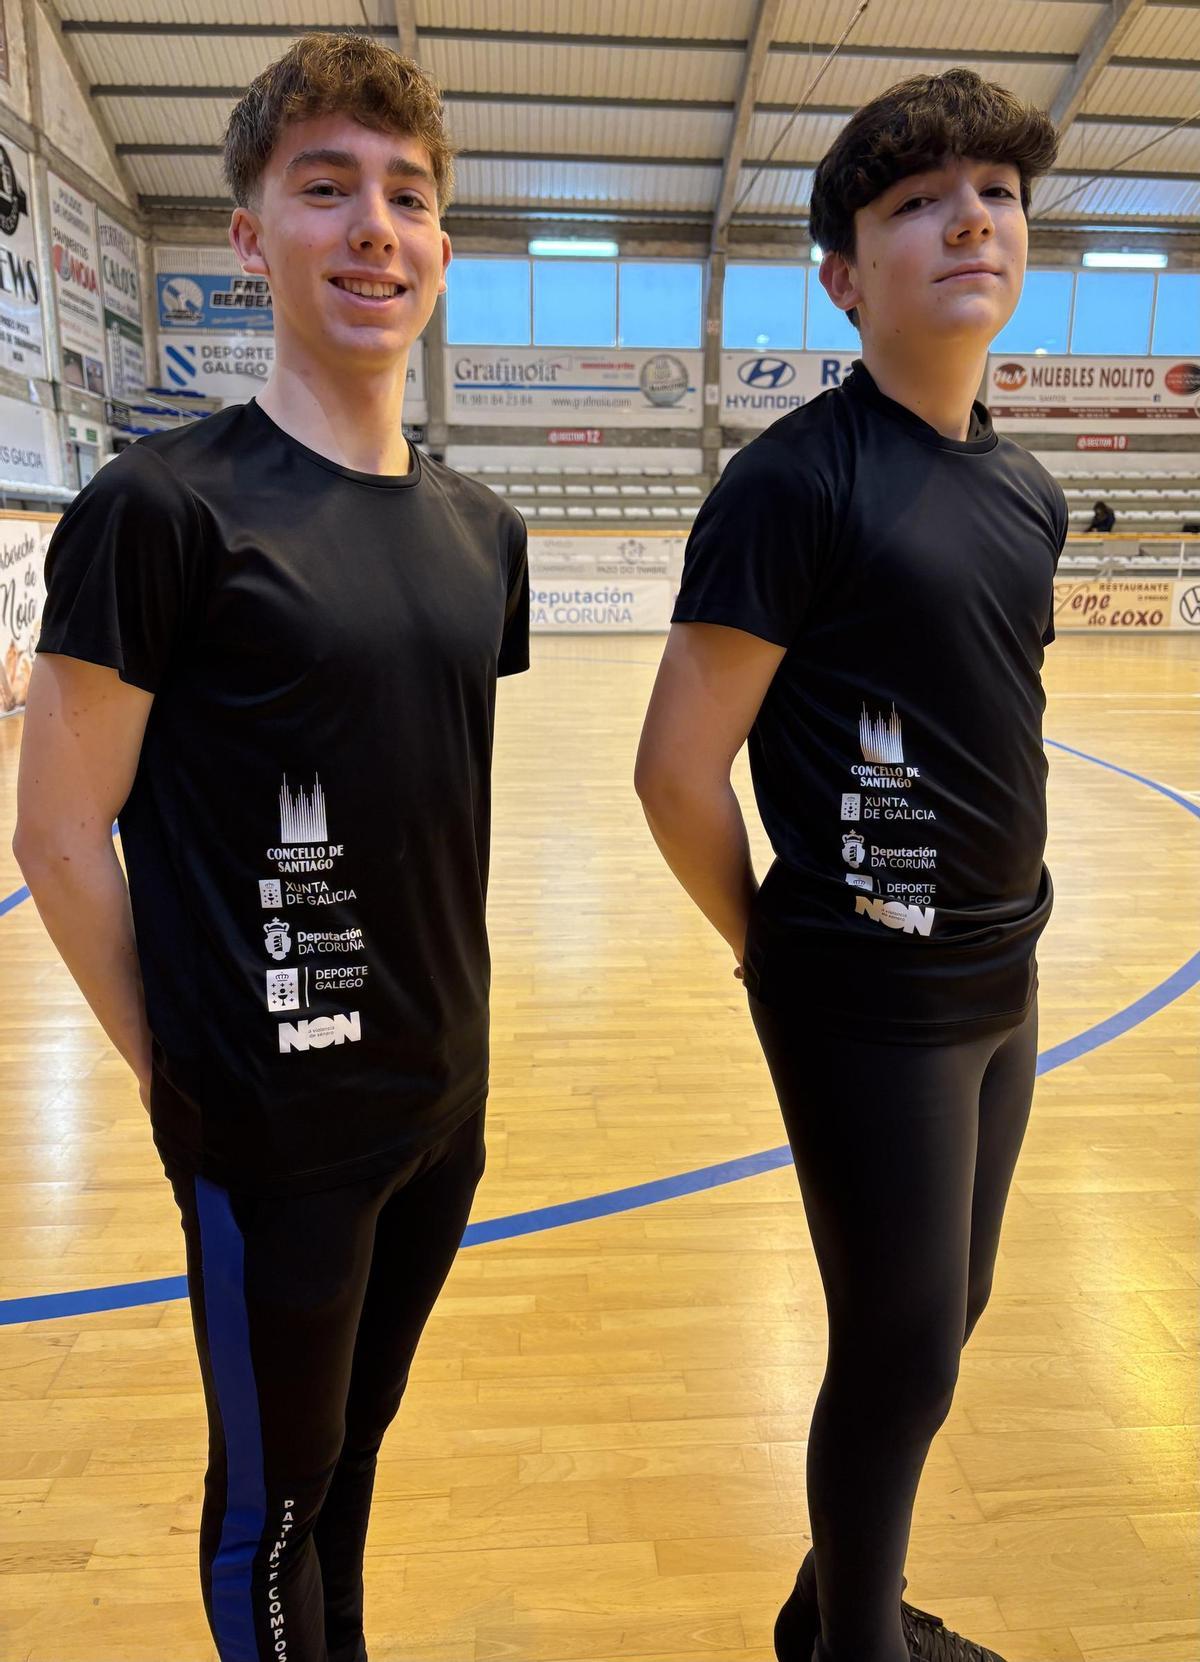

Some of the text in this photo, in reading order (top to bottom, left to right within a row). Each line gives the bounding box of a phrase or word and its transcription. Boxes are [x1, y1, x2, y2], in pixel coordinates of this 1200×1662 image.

[202, 346, 274, 361] DEPORTE
[203, 361, 268, 376] GALEGO
[1031, 367, 1094, 388] MUEBLES
[1100, 367, 1155, 388] NOLITO
[726, 395, 806, 409] HYUNDAI
[24, 562, 37, 587] de
[1099, 583, 1169, 591] RESTAURANTE
[0, 578, 37, 640] Noia
[554, 604, 633, 624] CORUÑA
[1088, 611, 1106, 626] do
[851, 765, 921, 778] CONCELLO DE
[860, 776, 912, 789] SANTIAGO
[864, 796, 909, 808] XUNTA
[864, 808, 937, 821] DE GALICIA
[266, 844, 344, 861] CONCELLO DE
[871, 845, 937, 859] Deputación
[277, 858, 334, 873] SANTIAGO
[871, 855, 937, 869] DA CORUÑA
[285, 880, 329, 894] XUNTA
[887, 883, 937, 894] DEPORTE
[286, 889, 357, 906] DE GALICIA
[888, 895, 931, 905] LEGO
[854, 895, 936, 937] NON
[297, 928, 363, 944] Deputación
[298, 939, 365, 955] DA CORUÑA
[315, 965, 369, 980] DEPORTE
[315, 978, 364, 990] GALEGO
[278, 1010, 362, 1053] NON
